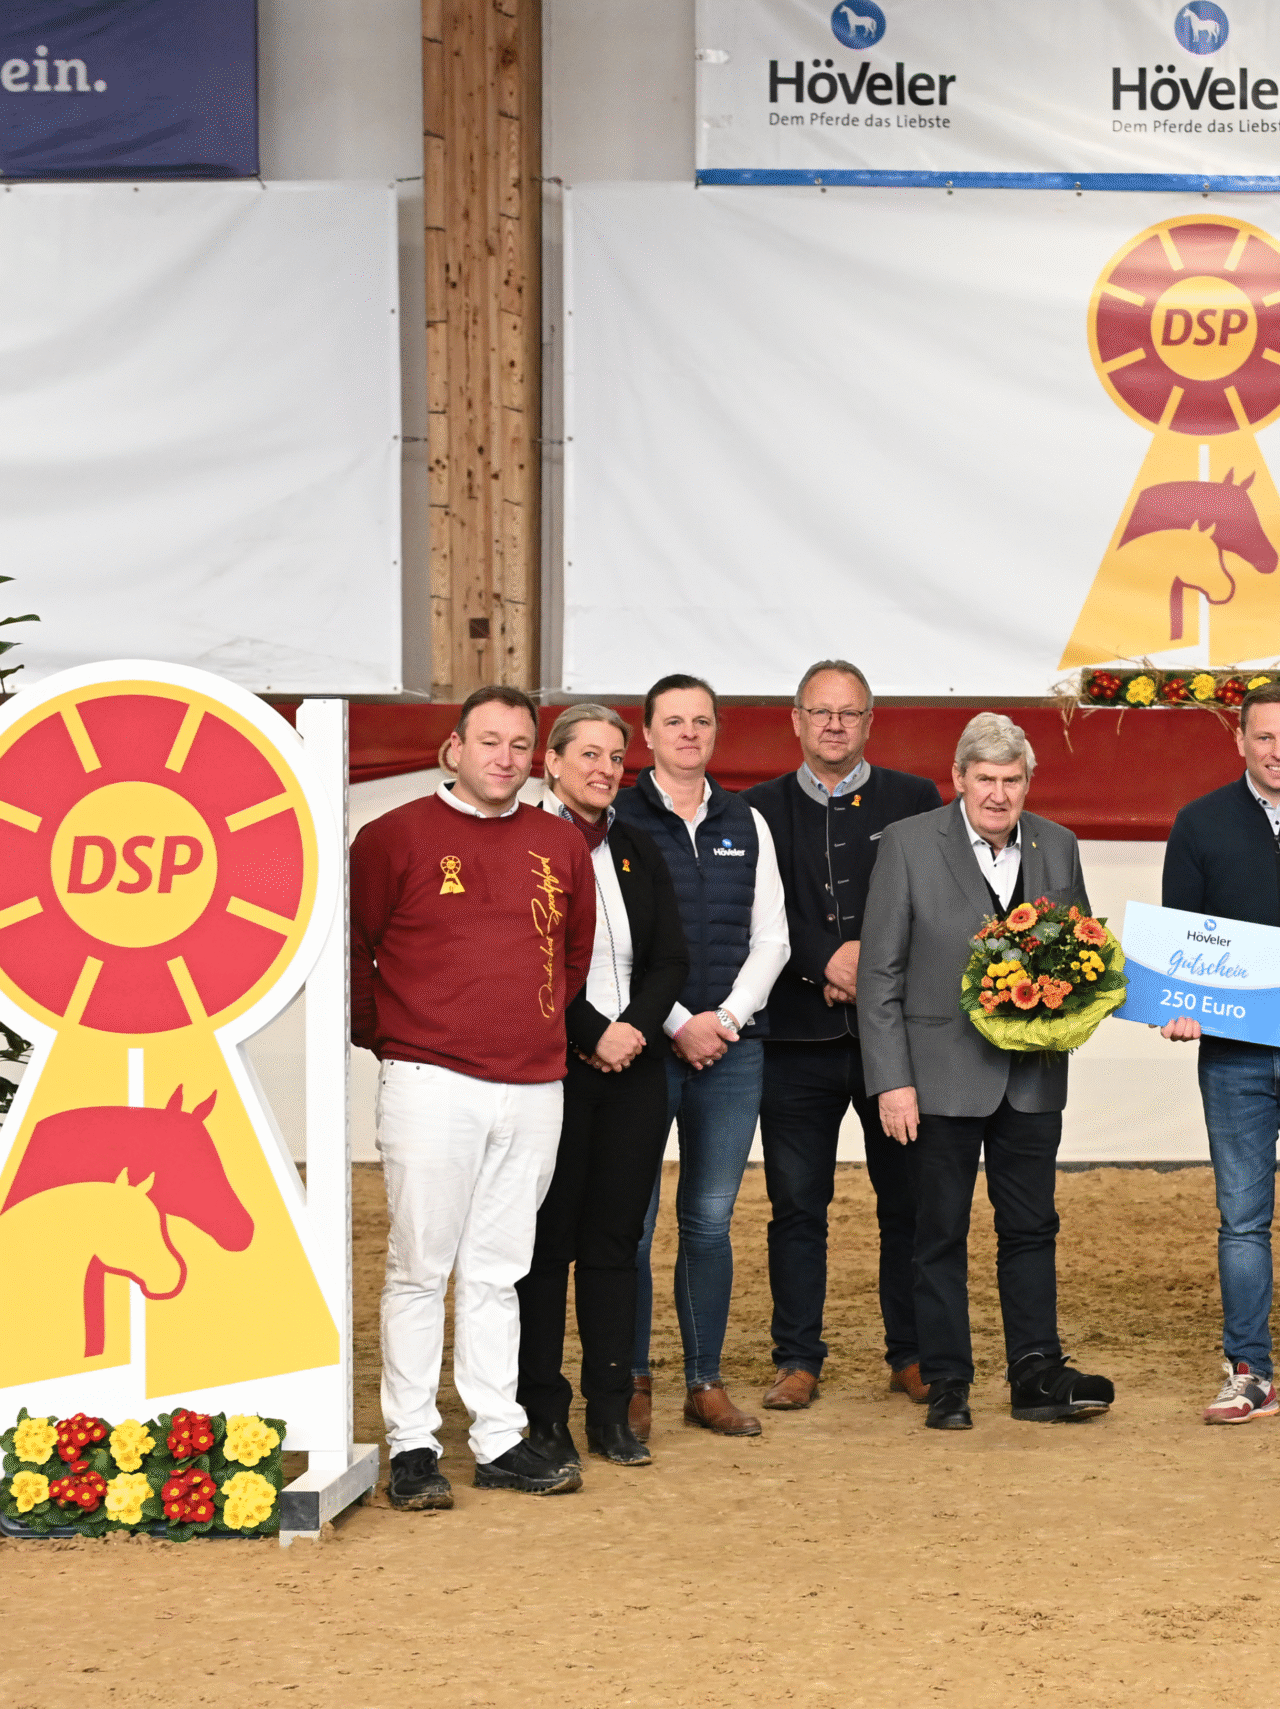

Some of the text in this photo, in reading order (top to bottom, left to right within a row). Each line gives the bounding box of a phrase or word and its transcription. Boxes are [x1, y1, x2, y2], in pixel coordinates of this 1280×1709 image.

[0, 45, 108, 93] ein.
[769, 112, 951, 129] Dem Pferde das Liebste
[1112, 120, 1147, 133] Dem
[1153, 119, 1202, 133] Pferde
[1207, 119, 1234, 133] das
[1161, 308, 1249, 347] DSP
[67, 835, 204, 894] DSP
[1167, 949, 1249, 979] Gutschein
[1160, 989, 1247, 1020] 250 Euro
